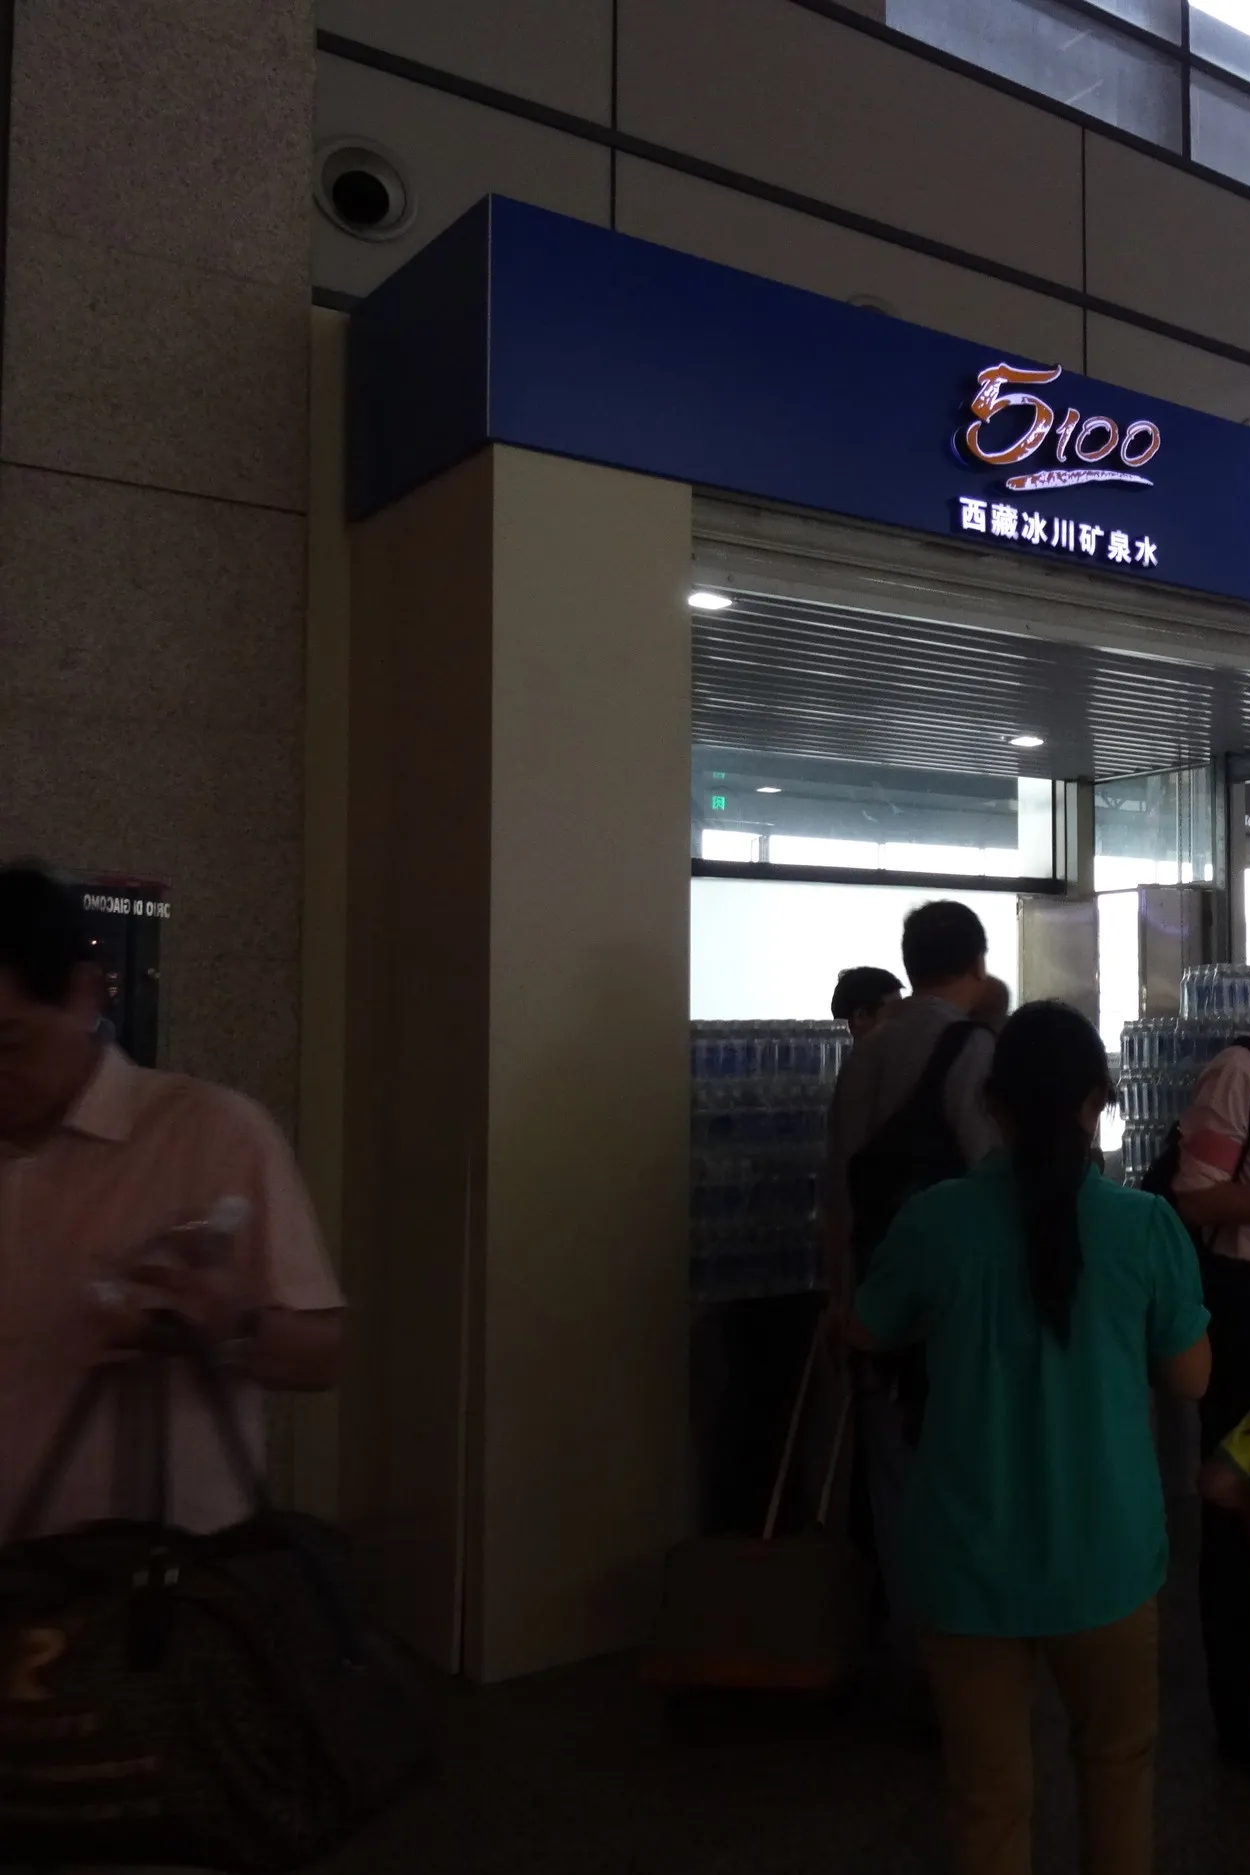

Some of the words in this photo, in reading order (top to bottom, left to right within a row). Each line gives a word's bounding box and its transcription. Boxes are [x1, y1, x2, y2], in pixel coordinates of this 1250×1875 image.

[965, 361, 1161, 468] 5100
[958, 496, 1159, 568] 西藏冰川矿泉水
